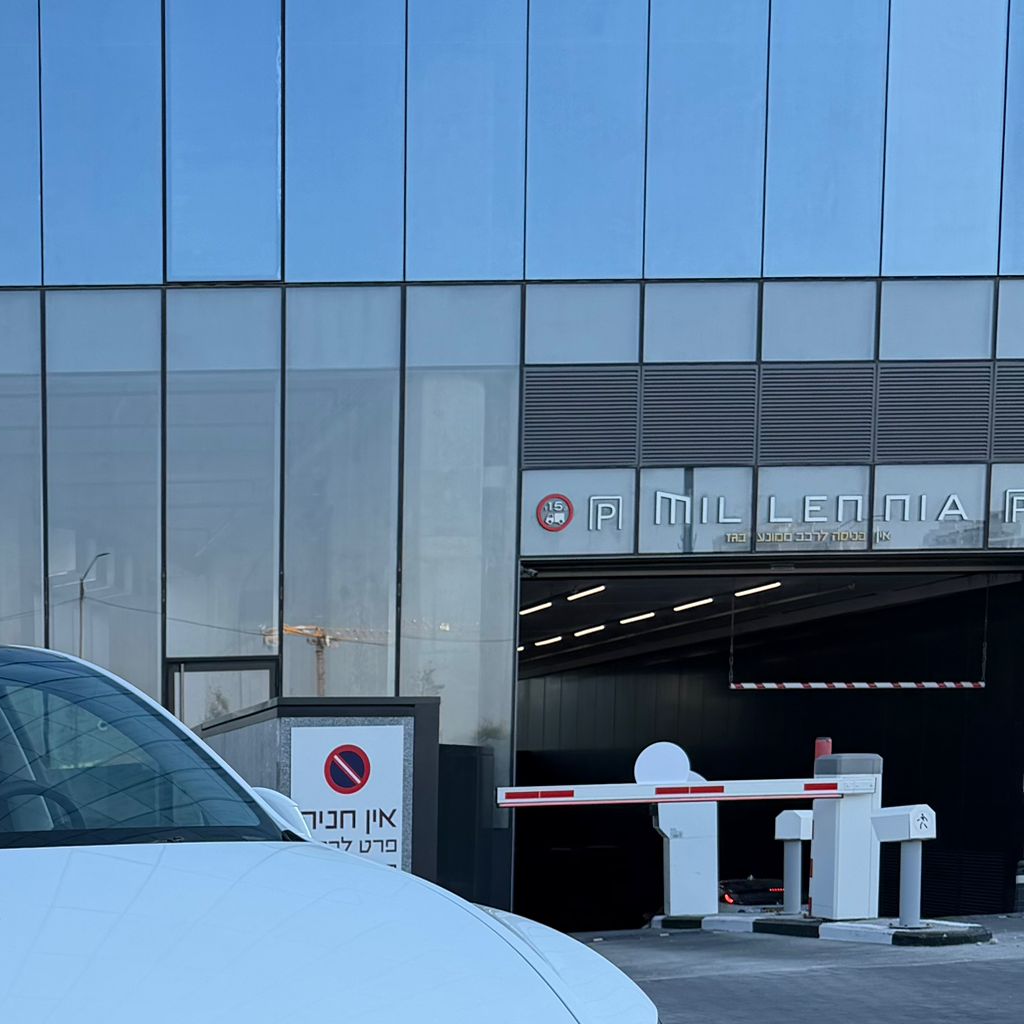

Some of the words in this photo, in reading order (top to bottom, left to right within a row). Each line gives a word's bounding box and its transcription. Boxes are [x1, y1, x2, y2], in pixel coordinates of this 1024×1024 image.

[795, 529, 829, 543] לרכב
[365, 808, 397, 834] אין
[359, 839, 397, 853] פרט
